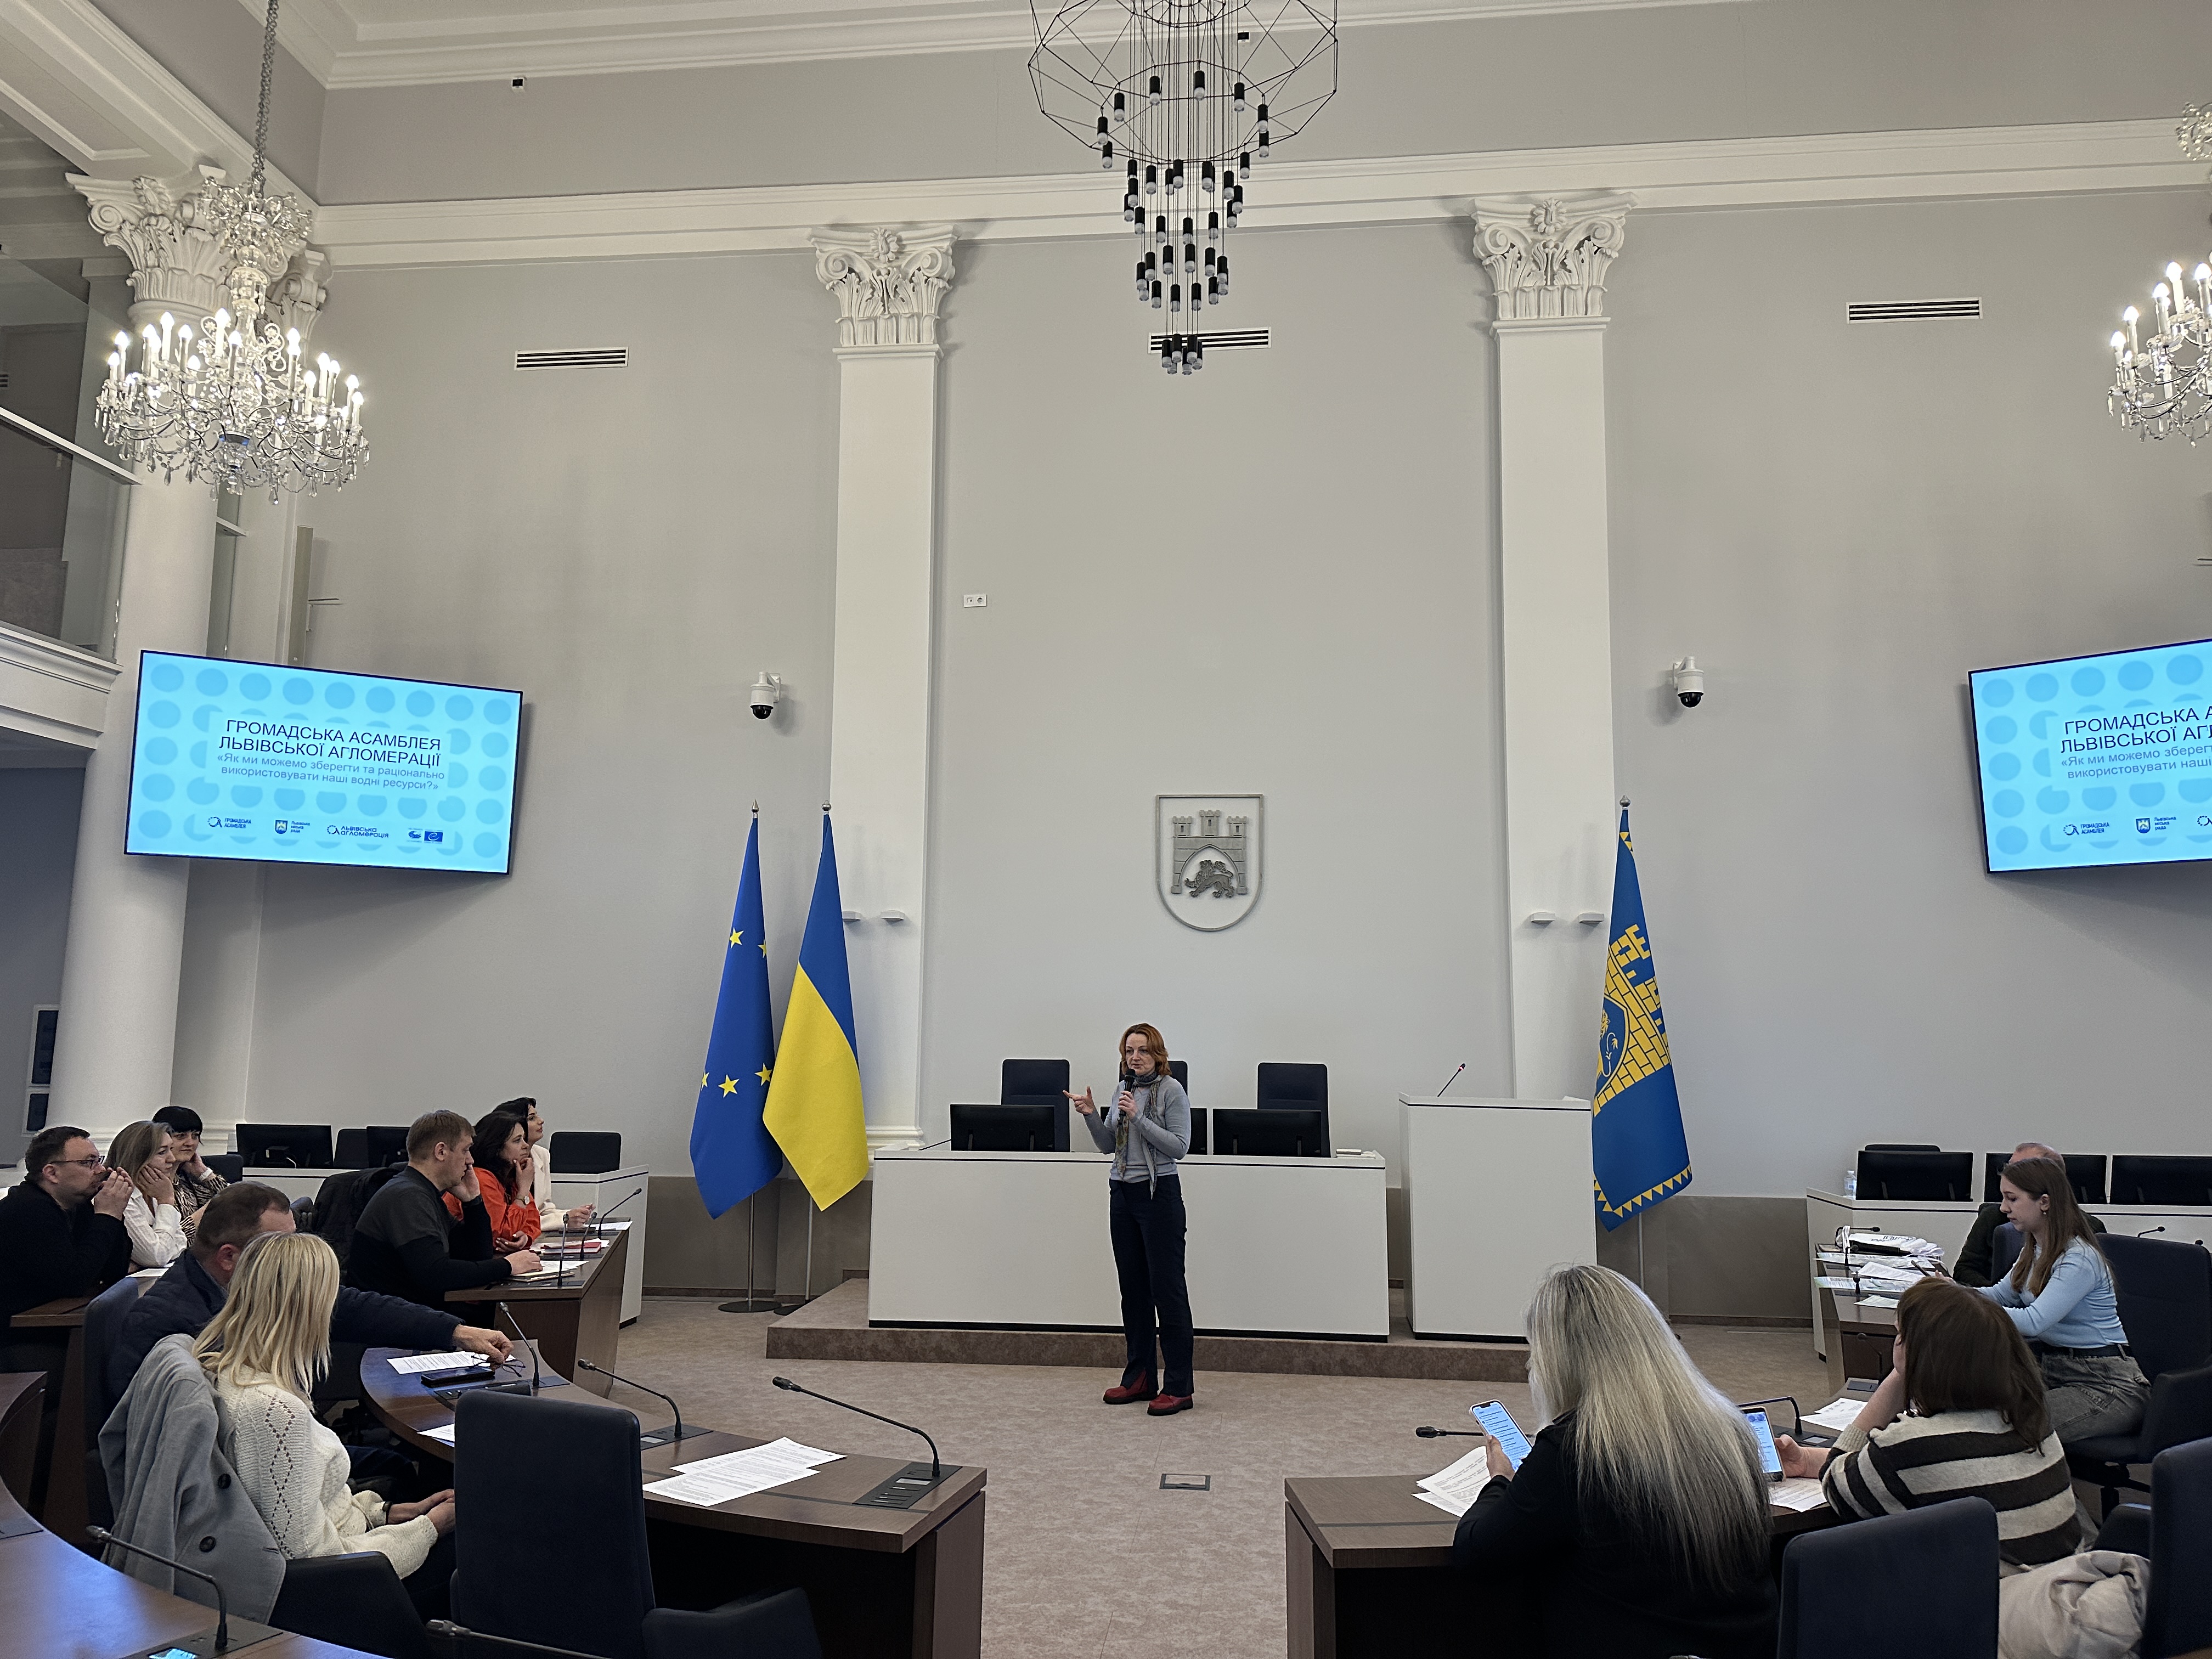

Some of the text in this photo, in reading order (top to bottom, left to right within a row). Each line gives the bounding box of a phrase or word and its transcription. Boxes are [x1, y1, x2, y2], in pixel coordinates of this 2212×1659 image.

[2065, 708, 2199, 735] ГРОМАДСЬКА
[227, 720, 440, 751] ГРОМАДСЬКА АСАМБЛЕЯ
[2061, 726, 2177, 753] ЛЬВІВСЬКОЇ
[219, 736, 441, 768] ЛЬВІВСЬКОЇ АГЛОМЕРАЦІЇ
[2061, 757, 2084, 766] «Як
[2087, 754, 2104, 764] ми
[2109, 751, 2160, 761] можемо
[217, 753, 239, 763] «Як
[261, 758, 307, 768] можемо
[311, 761, 359, 772] зберегти
[378, 768, 444, 779] раціонально
[221, 767, 438, 790] використовувати наші водні ресурси?»
[2068, 756, 2212, 778] використовувати наші
